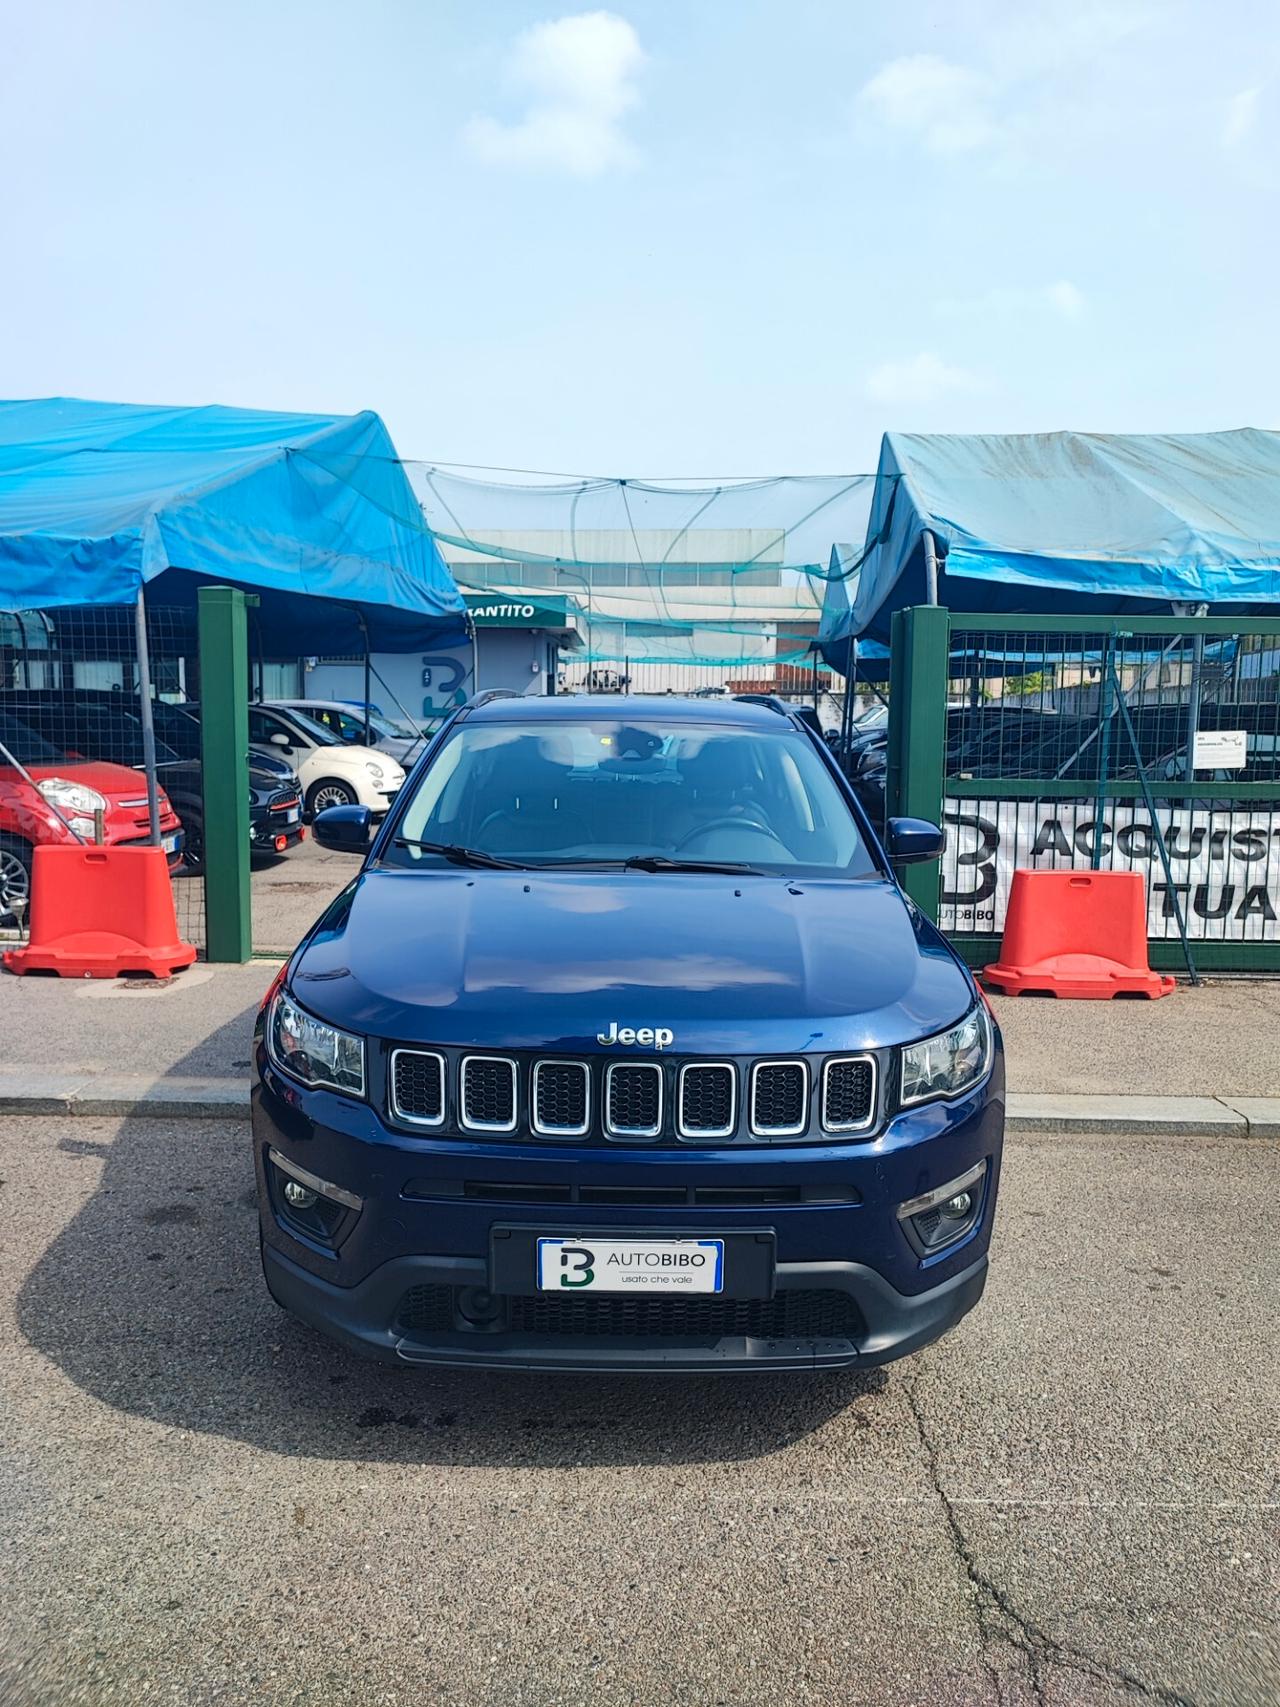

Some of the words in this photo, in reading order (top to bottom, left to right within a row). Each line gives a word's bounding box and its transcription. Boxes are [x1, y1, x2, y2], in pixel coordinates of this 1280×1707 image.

[1030, 819, 1280, 862] ACQUIS
[1153, 882, 1277, 920] TUA
[597, 1022, 674, 1050] Jeep
[606, 1252, 706, 1267] AUTOBIBO
[621, 1275, 649, 1284] usato
[649, 1275, 670, 1284] che
[671, 1276, 693, 1284] vale
